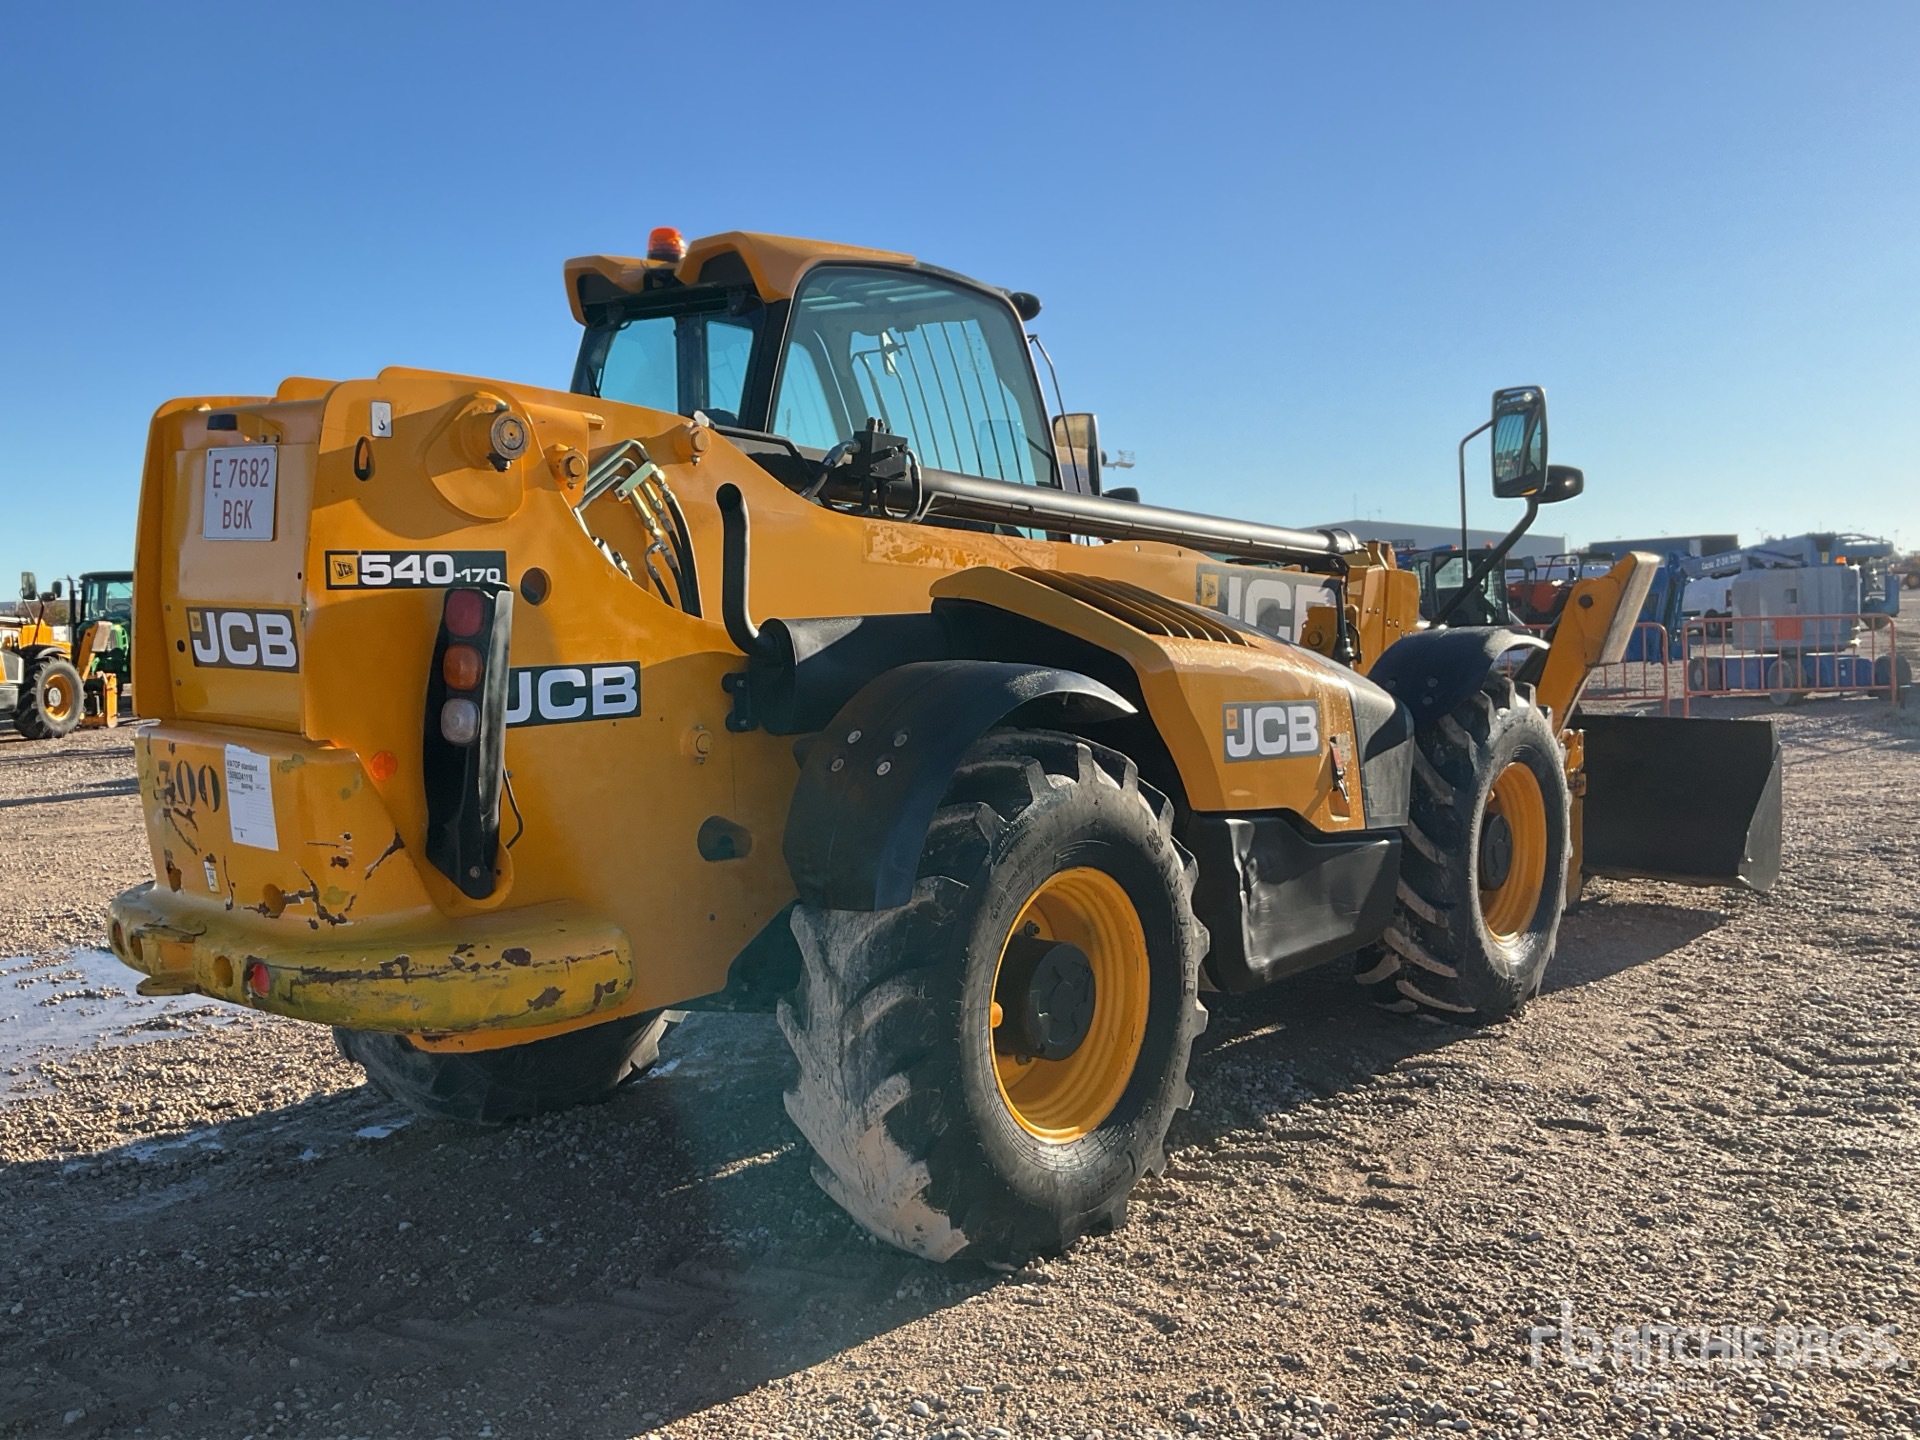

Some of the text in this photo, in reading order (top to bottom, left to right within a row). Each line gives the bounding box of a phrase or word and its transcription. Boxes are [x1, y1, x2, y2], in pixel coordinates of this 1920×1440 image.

[213, 457, 270, 488] E 7682
[222, 499, 254, 529] BGK
[361, 553, 501, 586] 540-170
[193, 611, 297, 668] JCB
[506, 665, 638, 724] JCB
[1226, 706, 1319, 758] JCB
